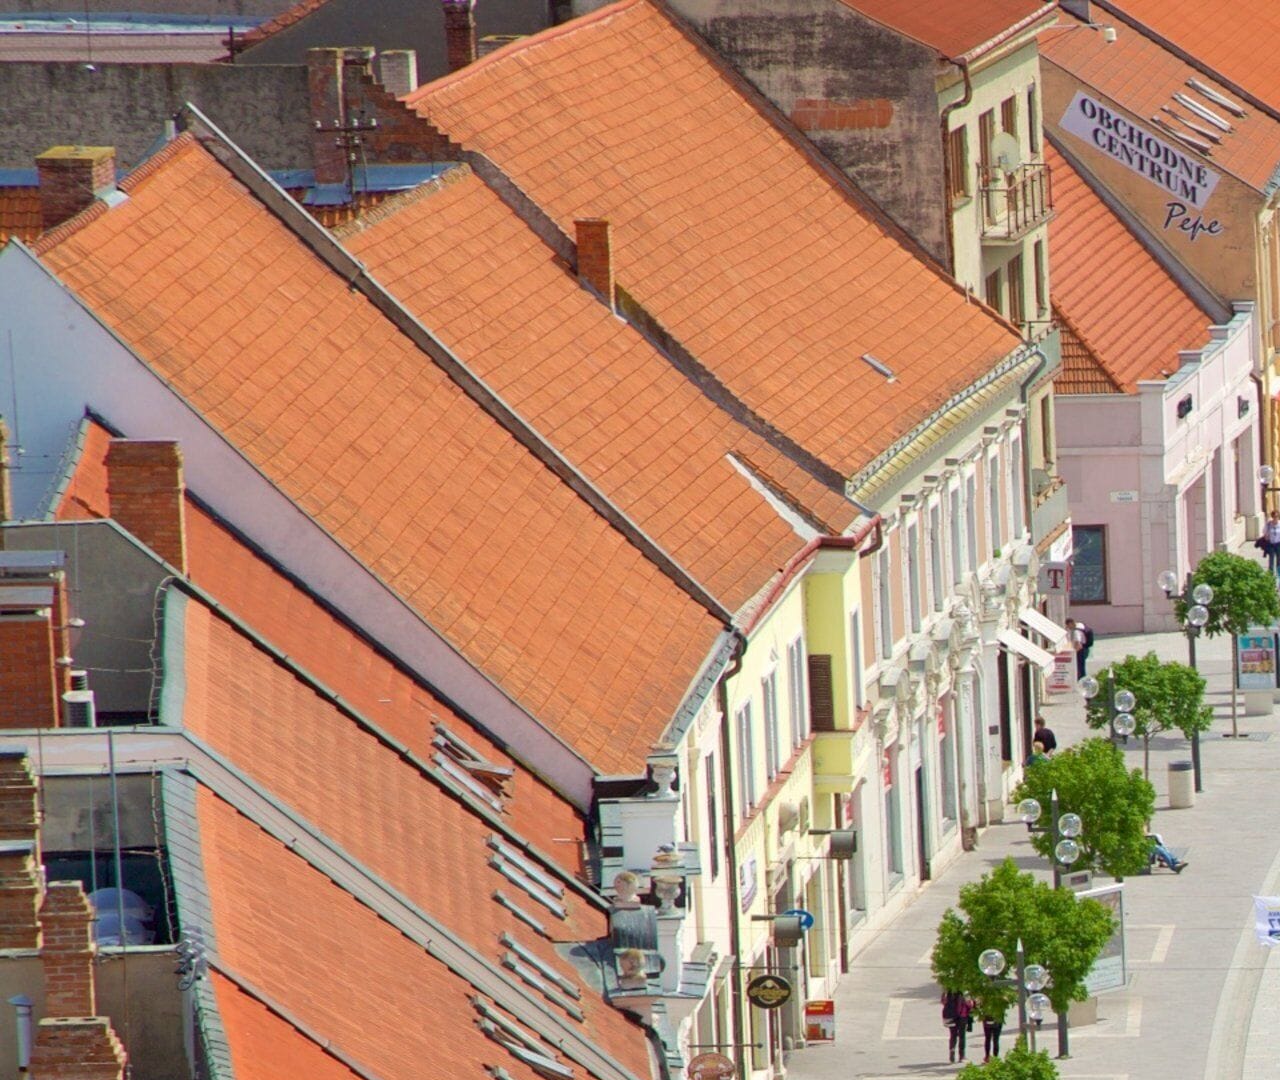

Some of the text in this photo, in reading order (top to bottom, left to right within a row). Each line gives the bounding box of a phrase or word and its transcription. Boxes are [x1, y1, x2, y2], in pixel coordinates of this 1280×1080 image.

[1092, 127, 1197, 204] CENTRUM
[1163, 202, 1221, 241] Pepe
[1047, 568, 1064, 589] T
